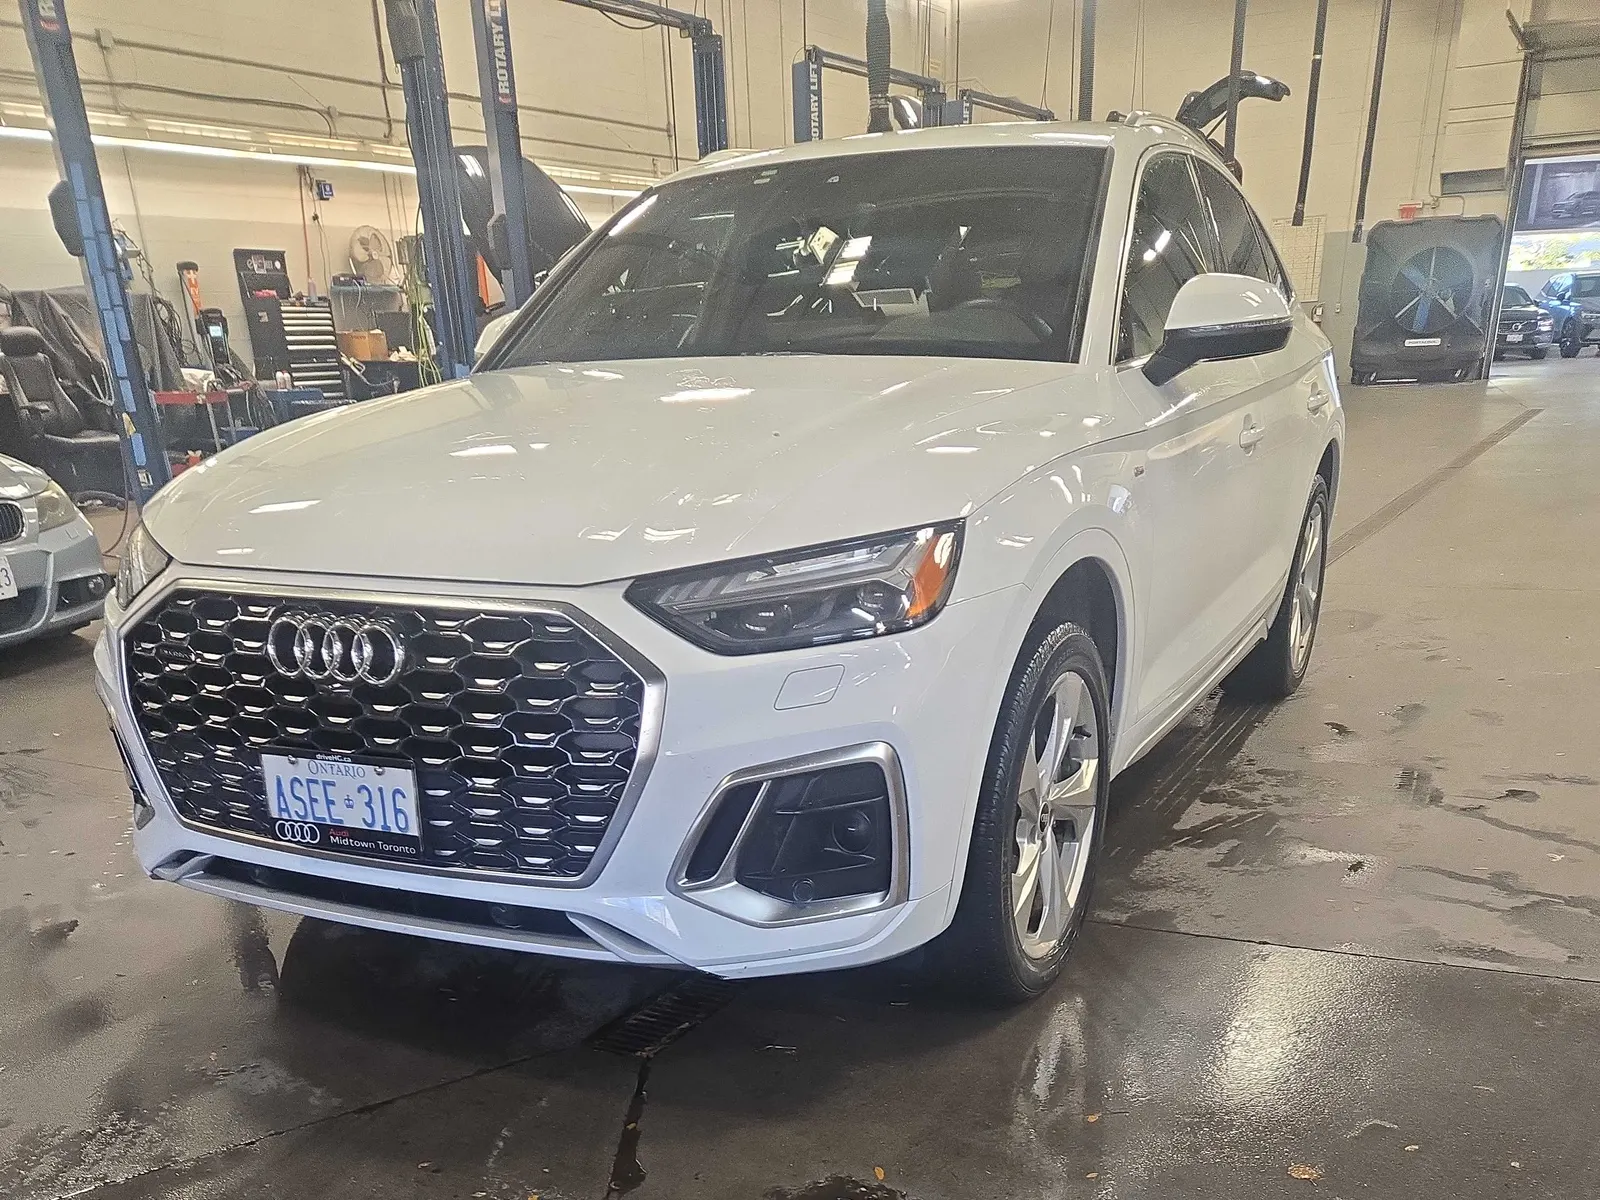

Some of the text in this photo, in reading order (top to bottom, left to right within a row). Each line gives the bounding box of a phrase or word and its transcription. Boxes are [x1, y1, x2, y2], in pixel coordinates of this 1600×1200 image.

[491, 23, 510, 94] ROTARY
[808, 61, 818, 90] LIFT
[308, 760, 366, 780] ONTARIO
[275, 775, 409, 833] ASEE 316
[329, 828, 349, 837] Audi
[330, 835, 417, 855] Midtown Toronto
